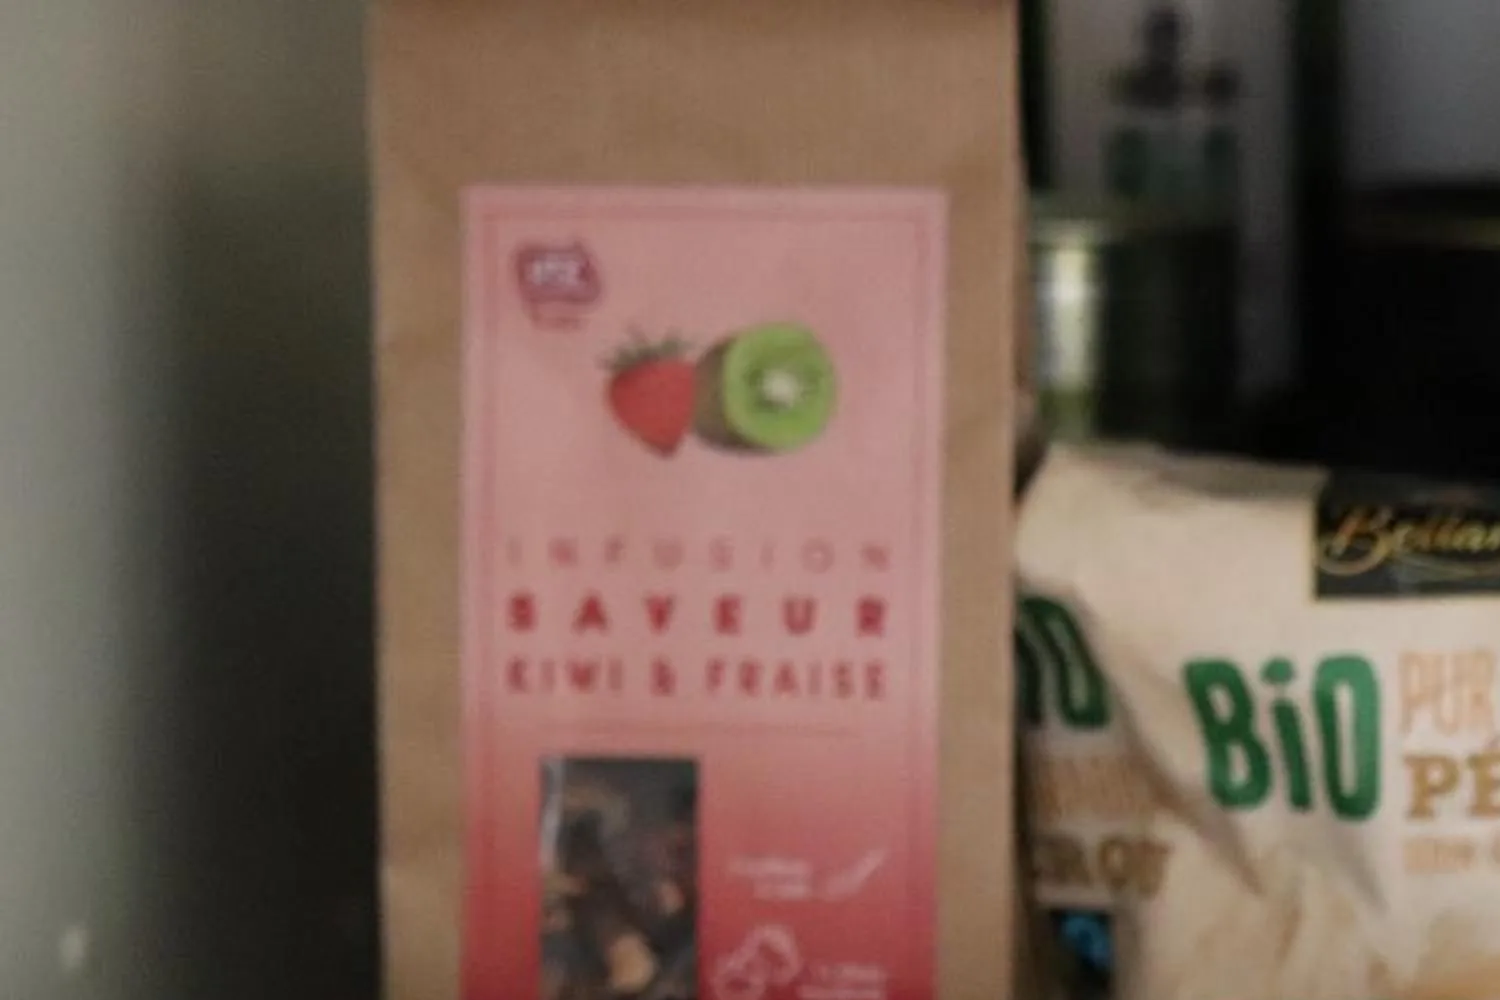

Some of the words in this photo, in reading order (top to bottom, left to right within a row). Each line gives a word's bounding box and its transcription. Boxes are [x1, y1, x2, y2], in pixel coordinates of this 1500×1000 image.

[507, 592, 887, 637] SAVEUR
[506, 657, 625, 695] KIWI
[705, 657, 888, 699] FRAISE
